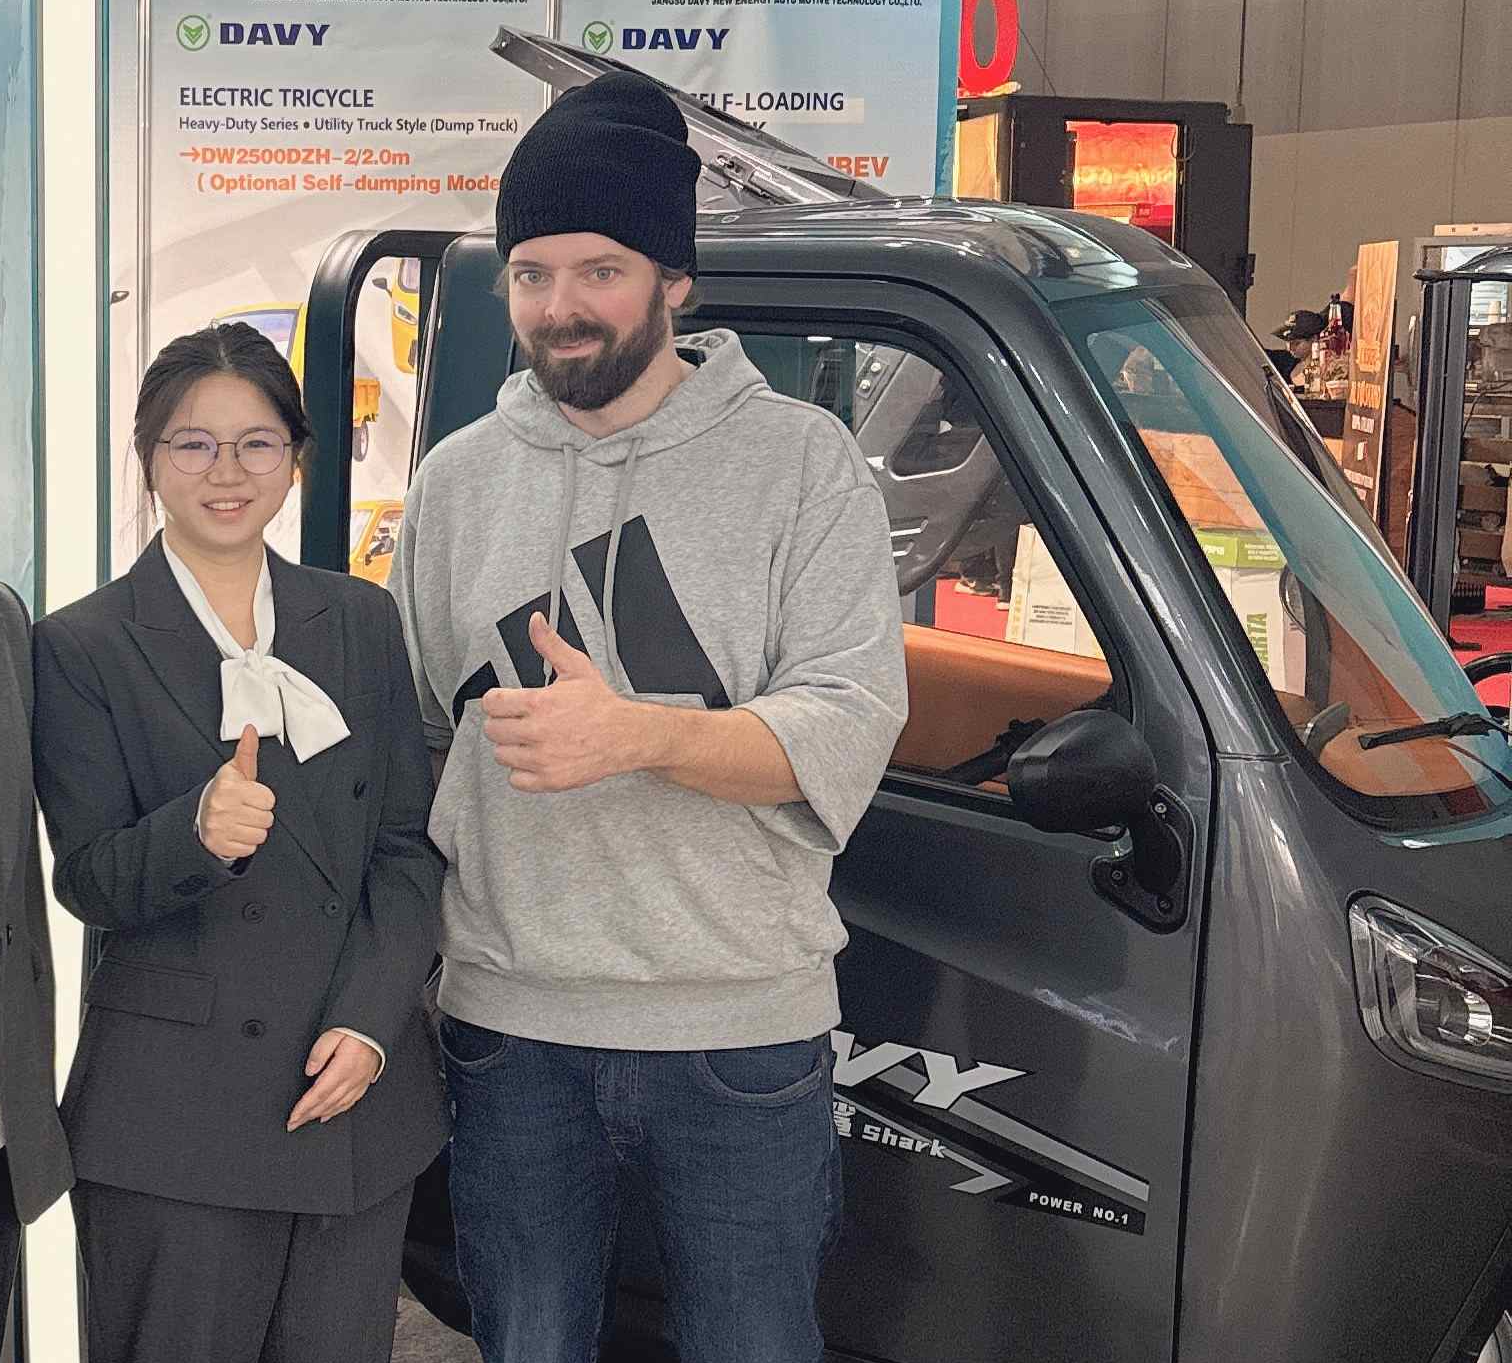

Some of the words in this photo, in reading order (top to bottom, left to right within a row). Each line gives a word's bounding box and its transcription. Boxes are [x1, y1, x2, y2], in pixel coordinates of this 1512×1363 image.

[219, 22, 331, 46] DAVY
[622, 29, 730, 50] DAVY
[179, 87, 273, 107] ELECTRIC
[278, 88, 374, 108] TRICYCLE
[179, 116, 259, 135] Heavy-Duty
[261, 117, 299, 131] Series
[314, 116, 354, 134] Utility
[357, 117, 393, 132] Truck
[396, 117, 427, 135] Style
[430, 117, 474, 135] (Dump
[476, 117, 518, 134] Truck)
[303, 174, 441, 195] Self-dumping
[830, 1030, 1033, 1109] VY
[862, 1124, 947, 1158] Shark
[1029, 1192, 1083, 1214] POWER
[1093, 1206, 1129, 1225] NO.1
